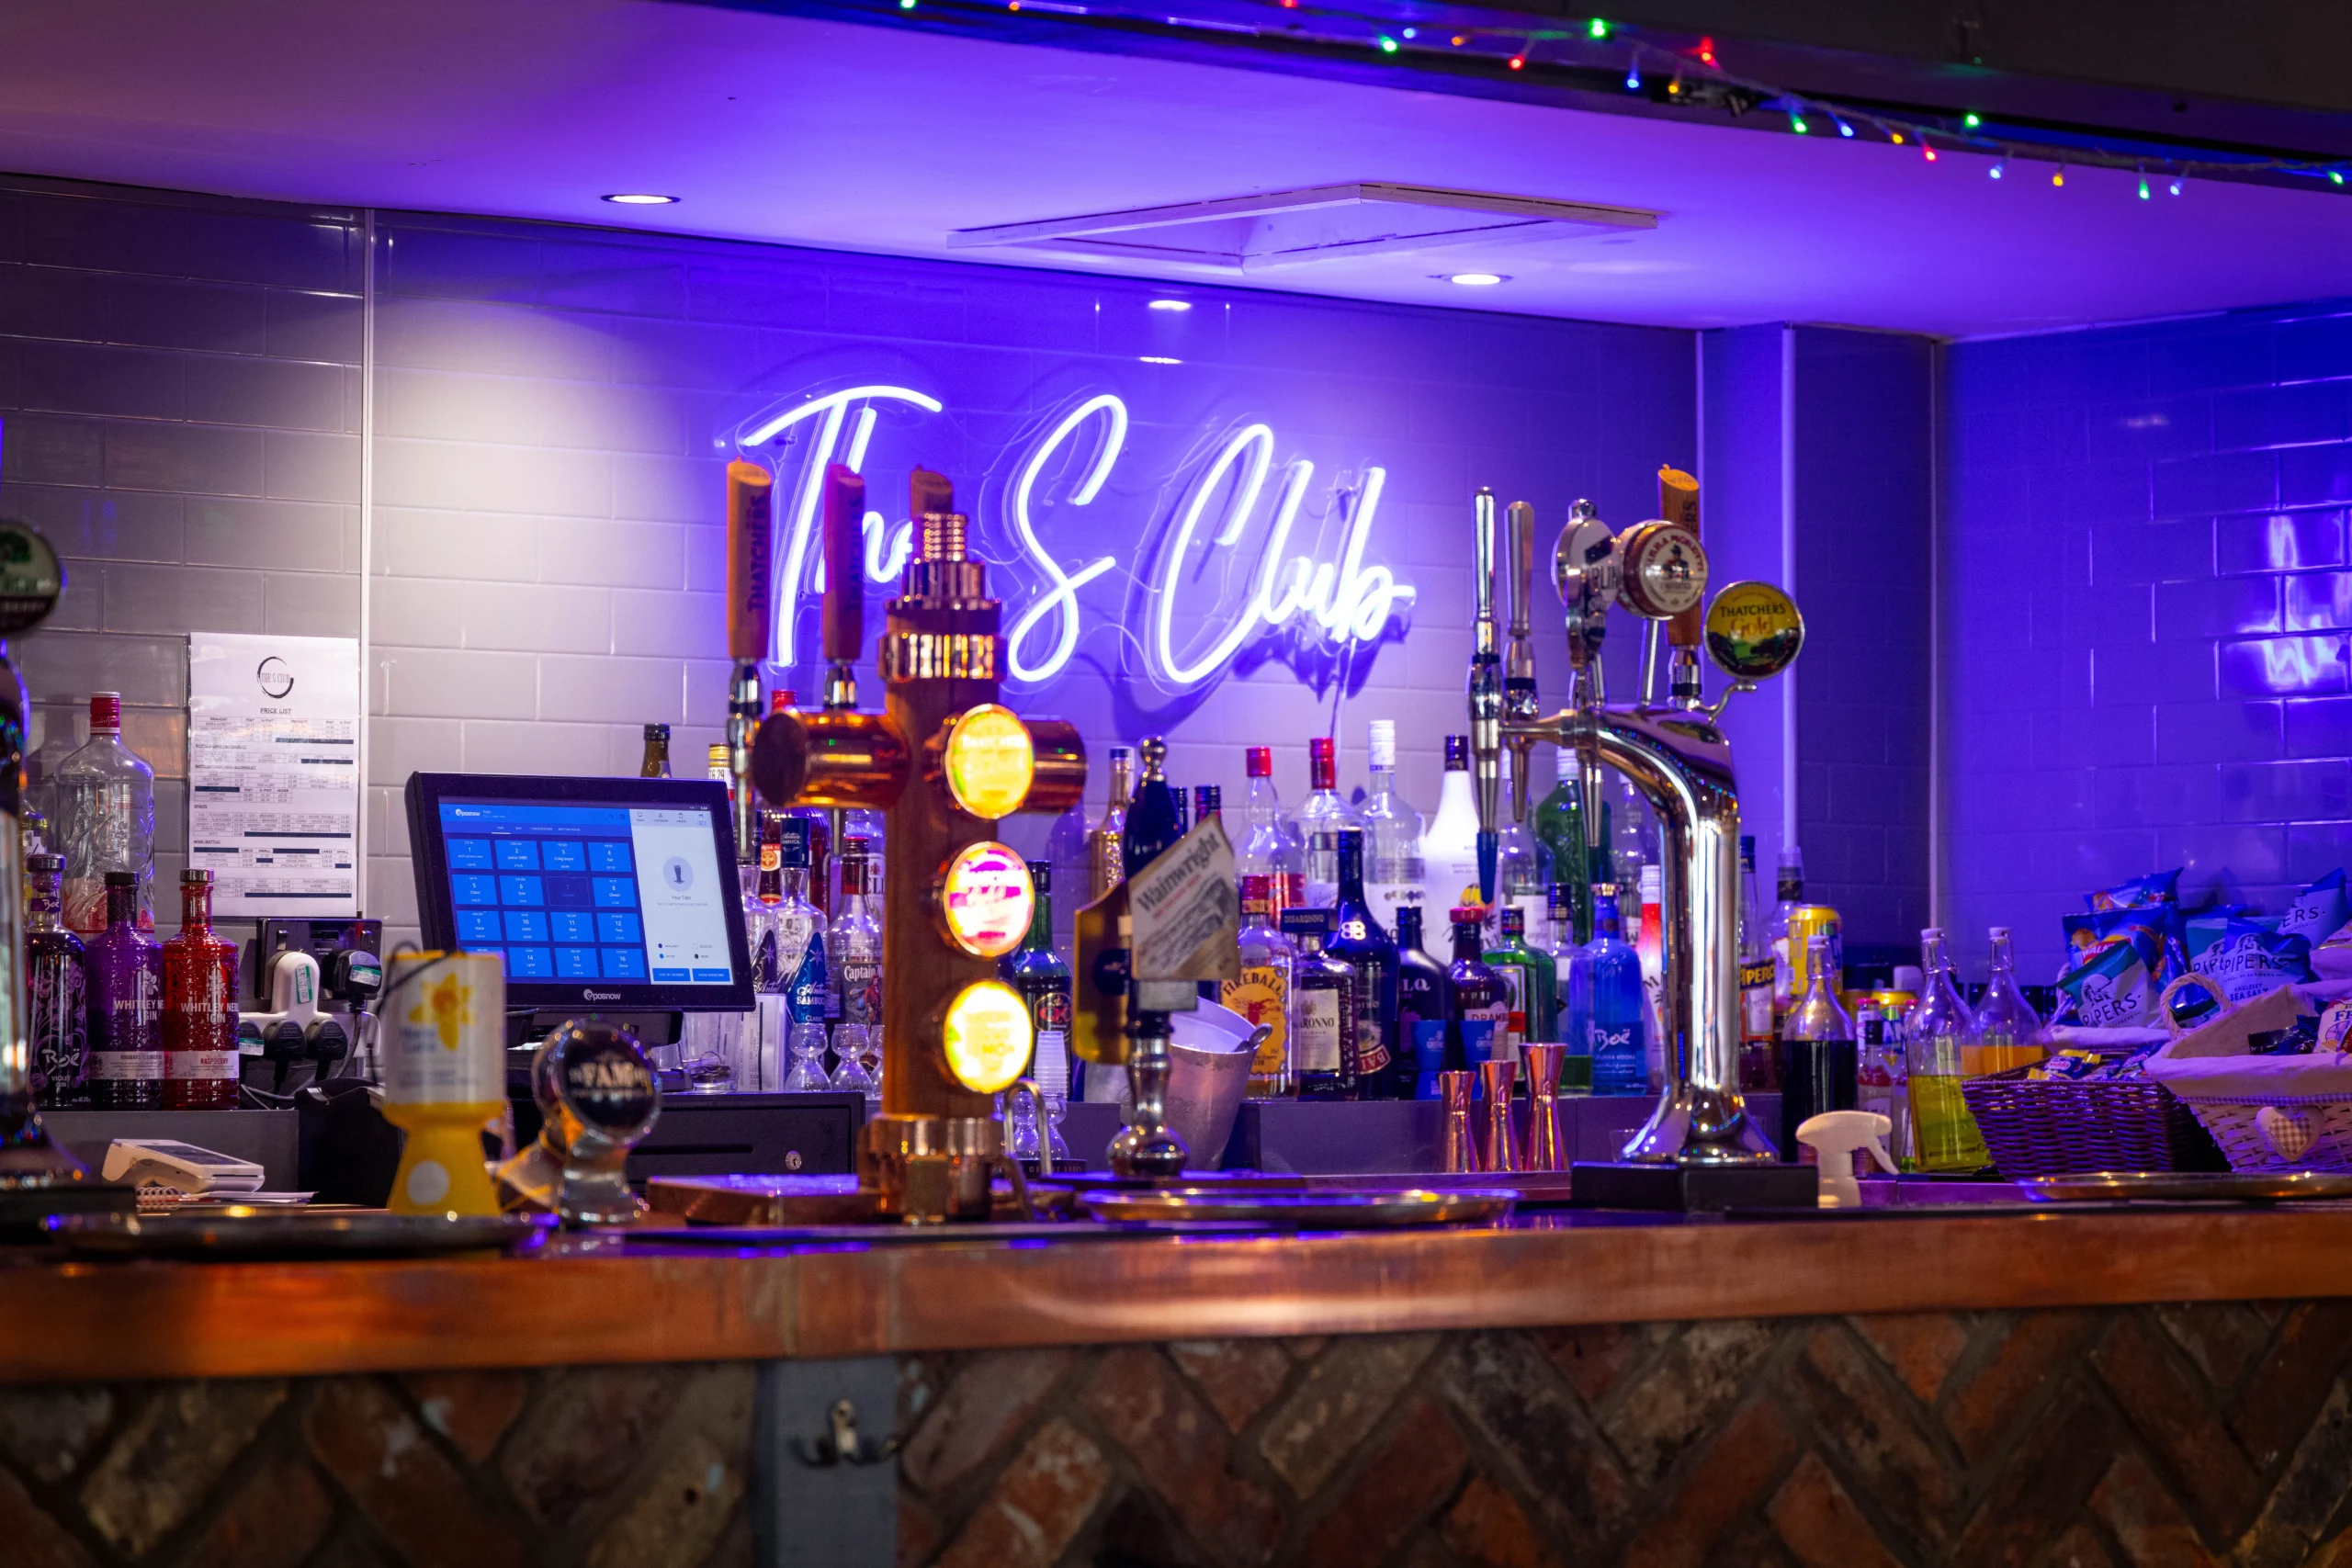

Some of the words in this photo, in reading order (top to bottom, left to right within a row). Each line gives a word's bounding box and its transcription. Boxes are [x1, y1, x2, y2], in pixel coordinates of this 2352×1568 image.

[1007, 392, 1129, 684] S
[1155, 422, 1418, 686] Club
[746, 495, 766, 610] THATCHERS
[1719, 603, 1786, 618] THATCHERS
[1729, 616, 1774, 637] Gold
[261, 673, 271, 682] THE
[277, 673, 290, 682] CLUB
[1137, 830, 1220, 912] Wainwright
[42, 898, 60, 910] Boë
[1284, 914, 1325, 924] DISARONNO
[2223, 953, 2284, 977] PIPERS
[843, 964, 876, 983] Captain
[1223, 972, 1282, 997] FIREBALL
[2234, 983, 2263, 992] ANGLESEY
[583, 988, 621, 1001] eposnow
[2231, 992, 2246, 1002] SEA
[114, 999, 155, 1010] WHITLEY
[180, 1002, 225, 1013] WHITLEY
[2082, 992, 2138, 1028] PIPERS
[145, 1010, 157, 1021] GIN
[210, 1014, 226, 1023] GIN
[1595, 1028, 1631, 1052] Boë
[41, 1049, 81, 1076] Boë
